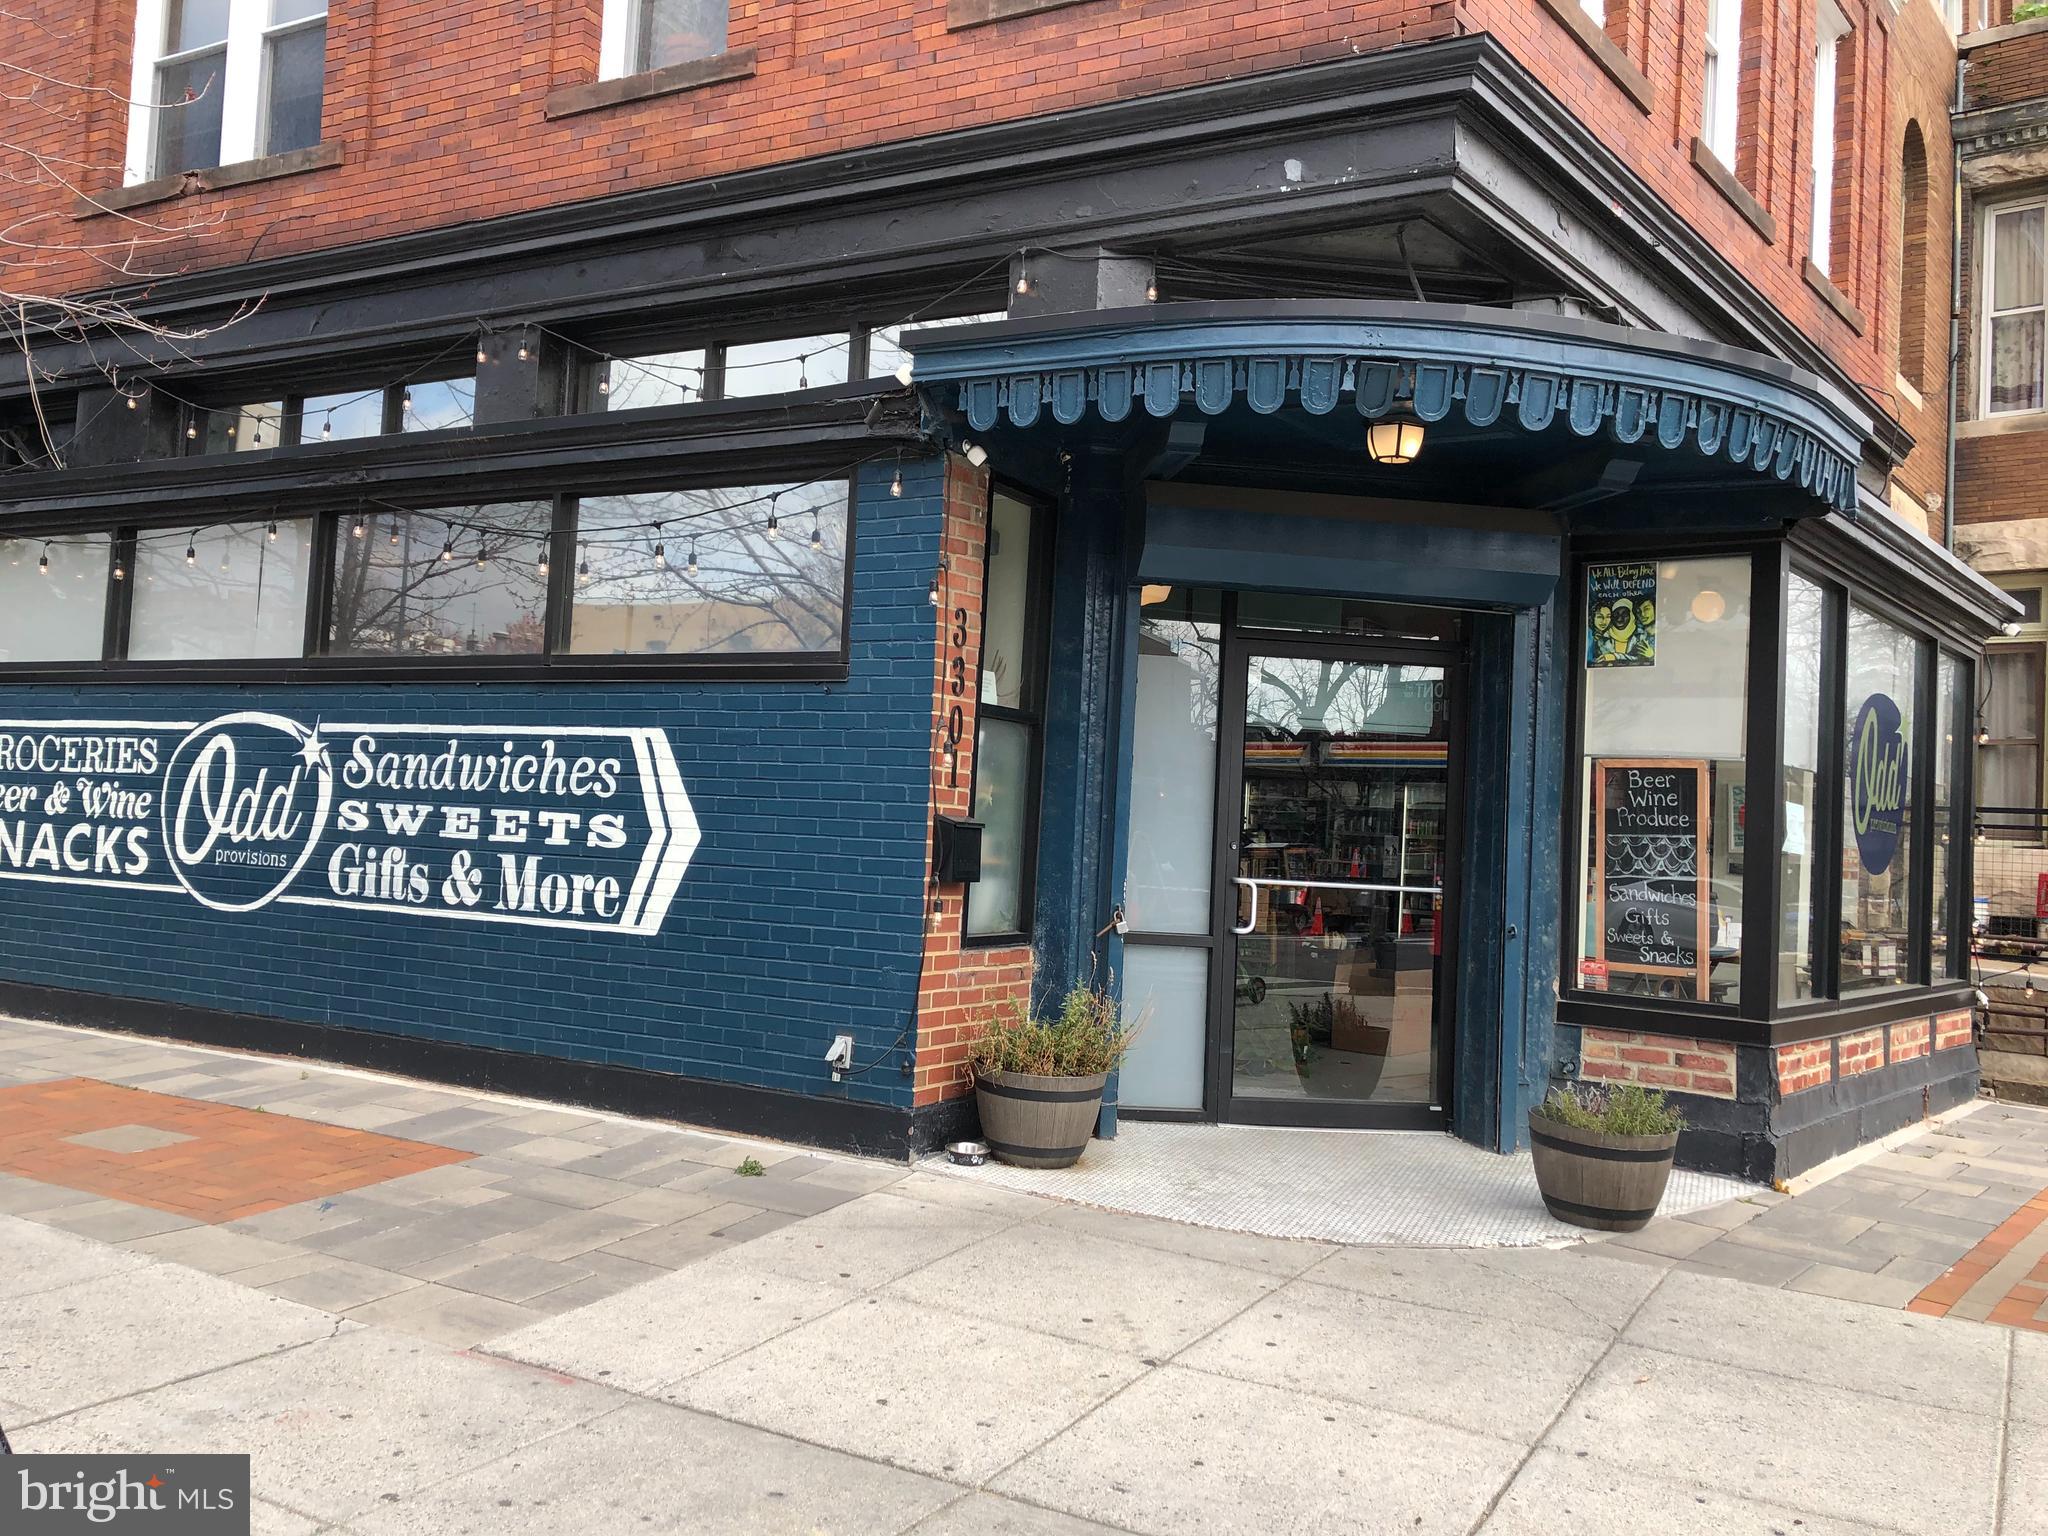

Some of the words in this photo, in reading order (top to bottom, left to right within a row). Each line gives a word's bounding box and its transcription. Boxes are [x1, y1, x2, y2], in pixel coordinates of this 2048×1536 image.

[1622, 578, 1656, 590] DEFEND
[342, 735, 621, 798] Sandwiches
[1854, 706, 1902, 835] Odd
[1628, 770, 1676, 789] Beer
[44, 780, 70, 816] &
[76, 777, 152, 820] Wine
[174, 733, 302, 865] Odd
[1628, 790, 1678, 808] Wine
[337, 800, 627, 849] SWEETS
[1616, 807, 1690, 828] Produce
[215, 848, 287, 868] provisions
[328, 843, 429, 904] Gifts
[441, 850, 482, 907] &
[492, 853, 620, 917] More
[1609, 882, 1697, 907] Sandwiches
[1625, 907, 1670, 926] Gifts
[1607, 928, 1654, 945] Sweets
[1661, 930, 1675, 946] &
[1639, 946, 1695, 965] Snacks
